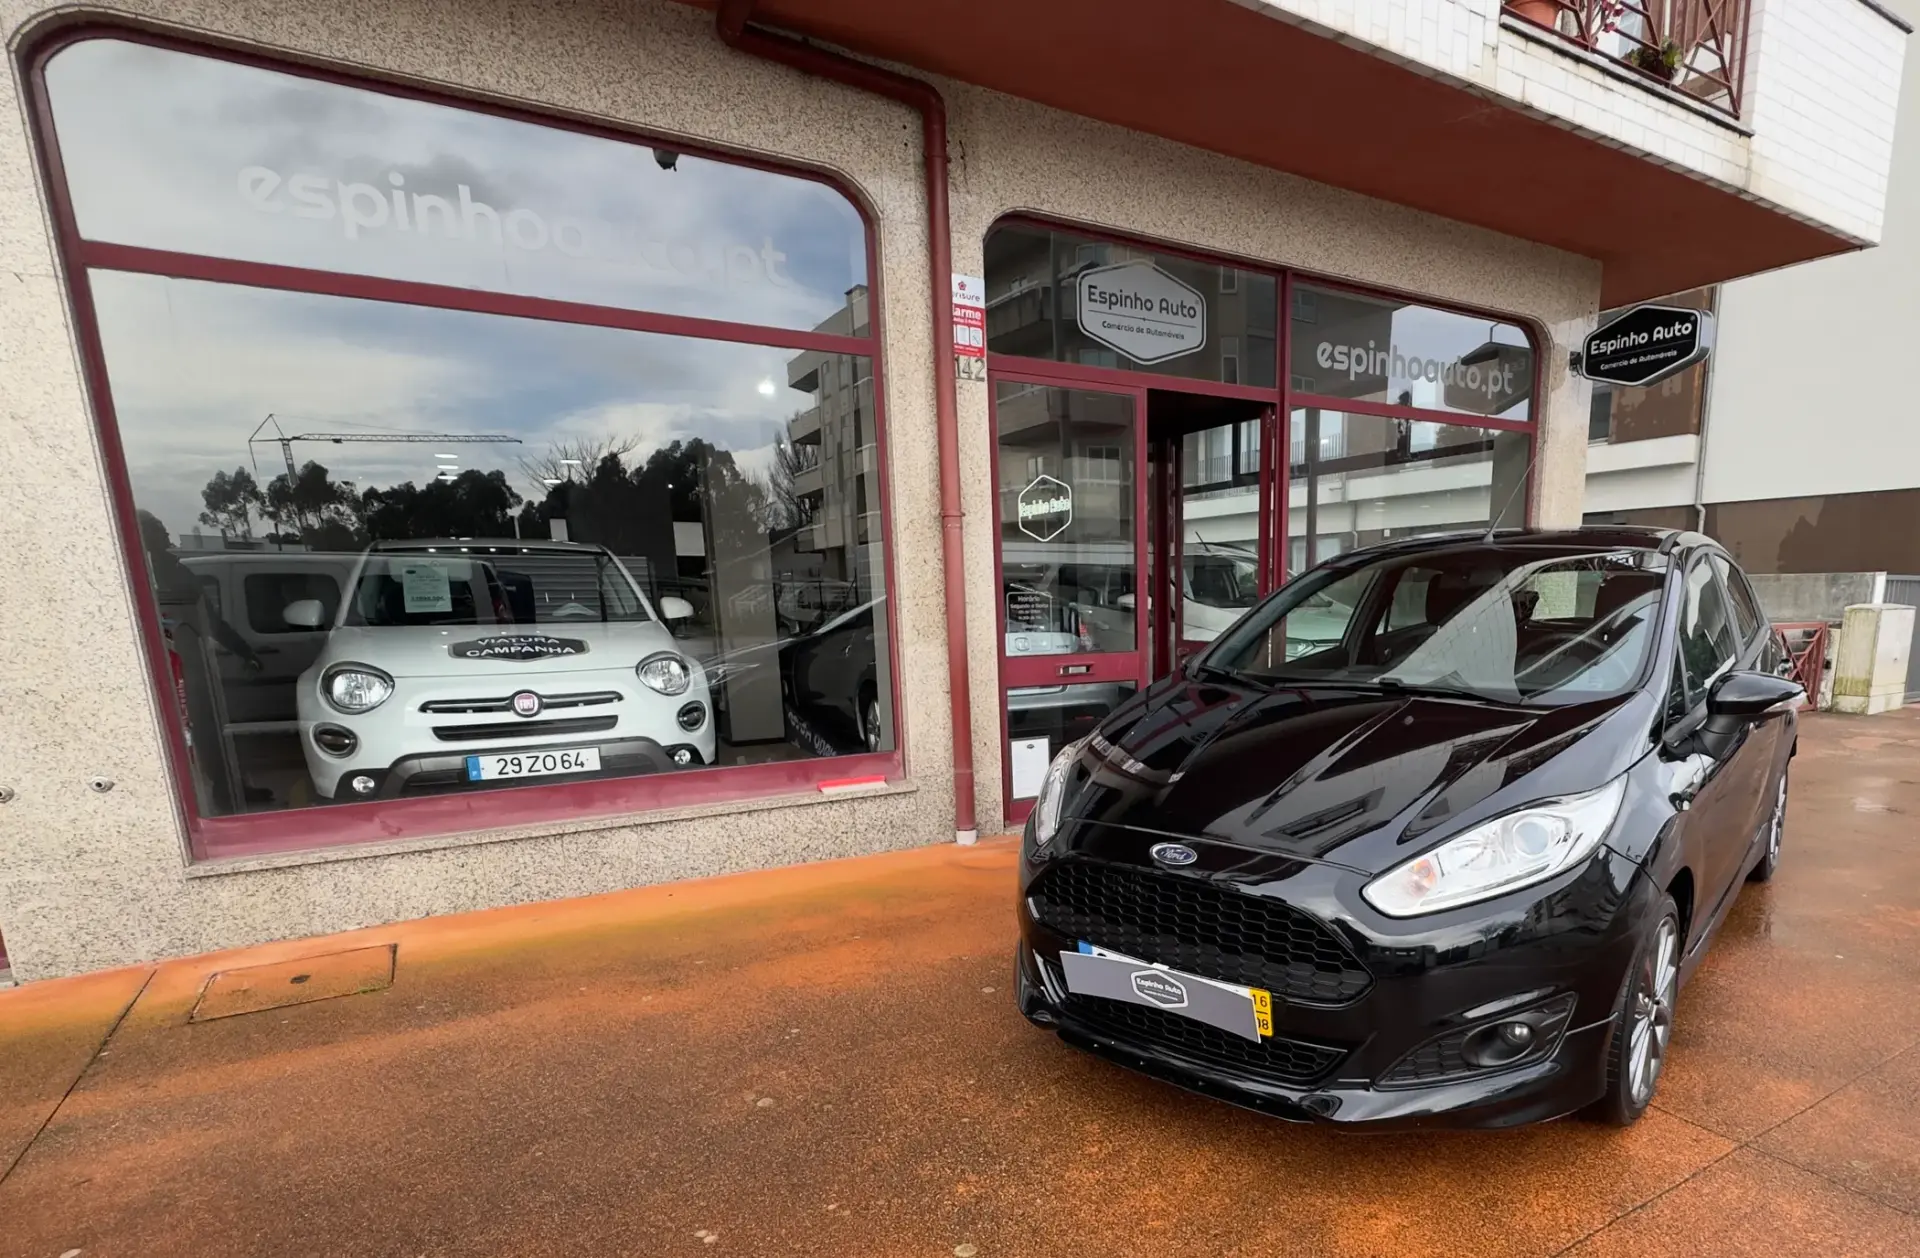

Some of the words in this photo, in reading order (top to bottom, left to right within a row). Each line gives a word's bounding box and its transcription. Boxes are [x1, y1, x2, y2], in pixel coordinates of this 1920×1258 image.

[1087, 284, 1154, 312] Espinho
[1159, 297, 1197, 319] Auto
[1136, 325, 1145, 334] de
[1590, 331, 1648, 355] Espinho
[1652, 321, 1692, 342] Auto
[1629, 357, 1638, 365] de
[955, 355, 986, 382] 142
[1316, 340, 1514, 399] espinhoauto.pt
[478, 637, 560, 646] VIATURA
[466, 645, 576, 657] CAMPANHA
[1160, 847, 1188, 860] Ford
